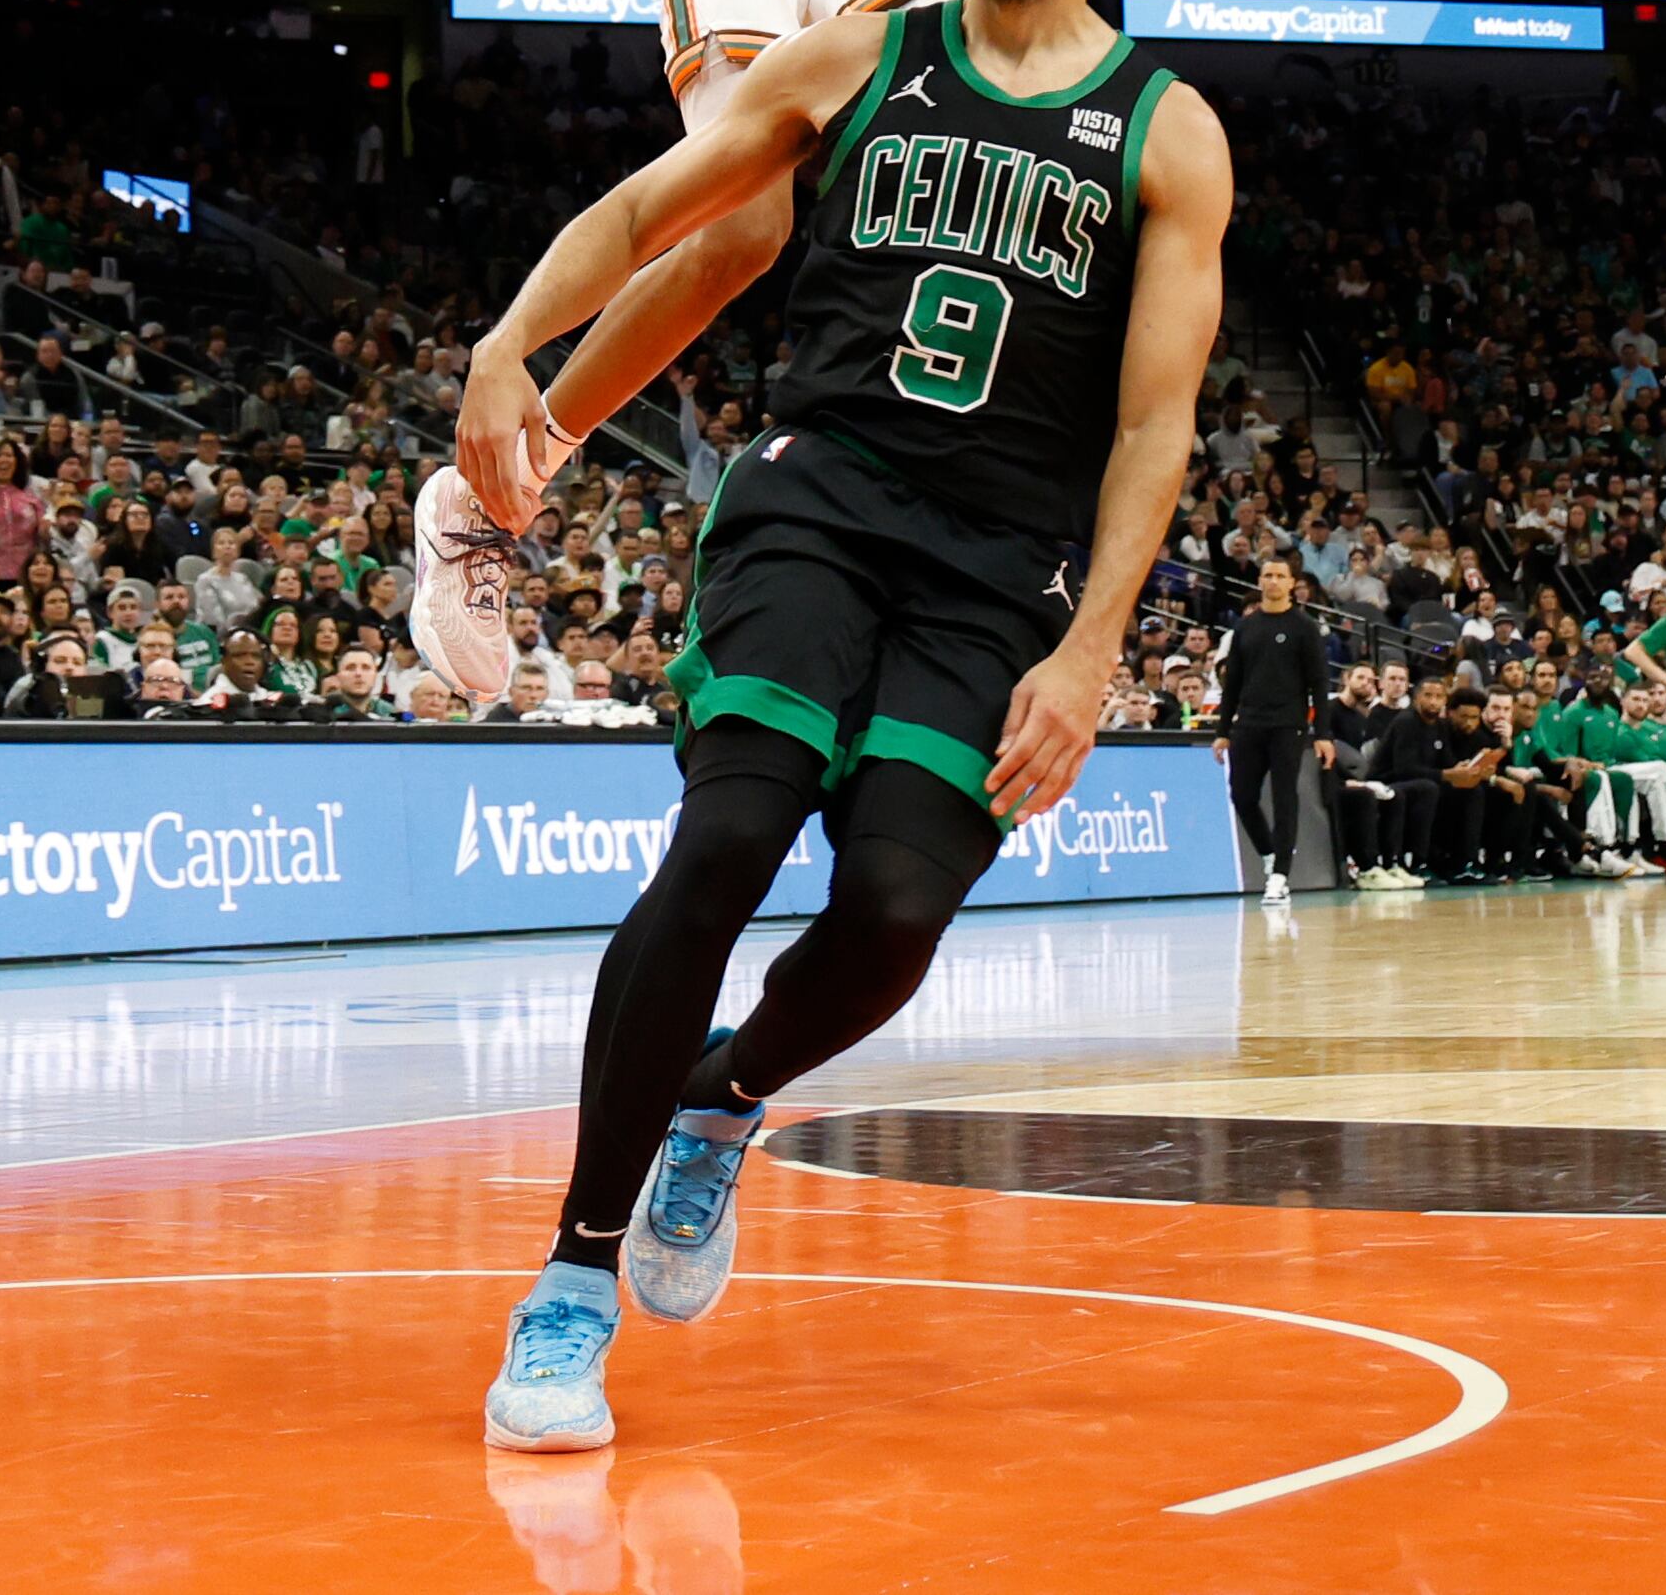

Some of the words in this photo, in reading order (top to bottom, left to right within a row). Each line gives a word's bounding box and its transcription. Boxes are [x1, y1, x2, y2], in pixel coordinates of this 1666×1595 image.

[1184, 2, 1387, 42] VictoryCapital
[1067, 125, 1121, 152] PRINT
[1072, 108, 1122, 137] VISTA
[851, 134, 1113, 298] CELTICS
[888, 262, 1014, 414] 9
